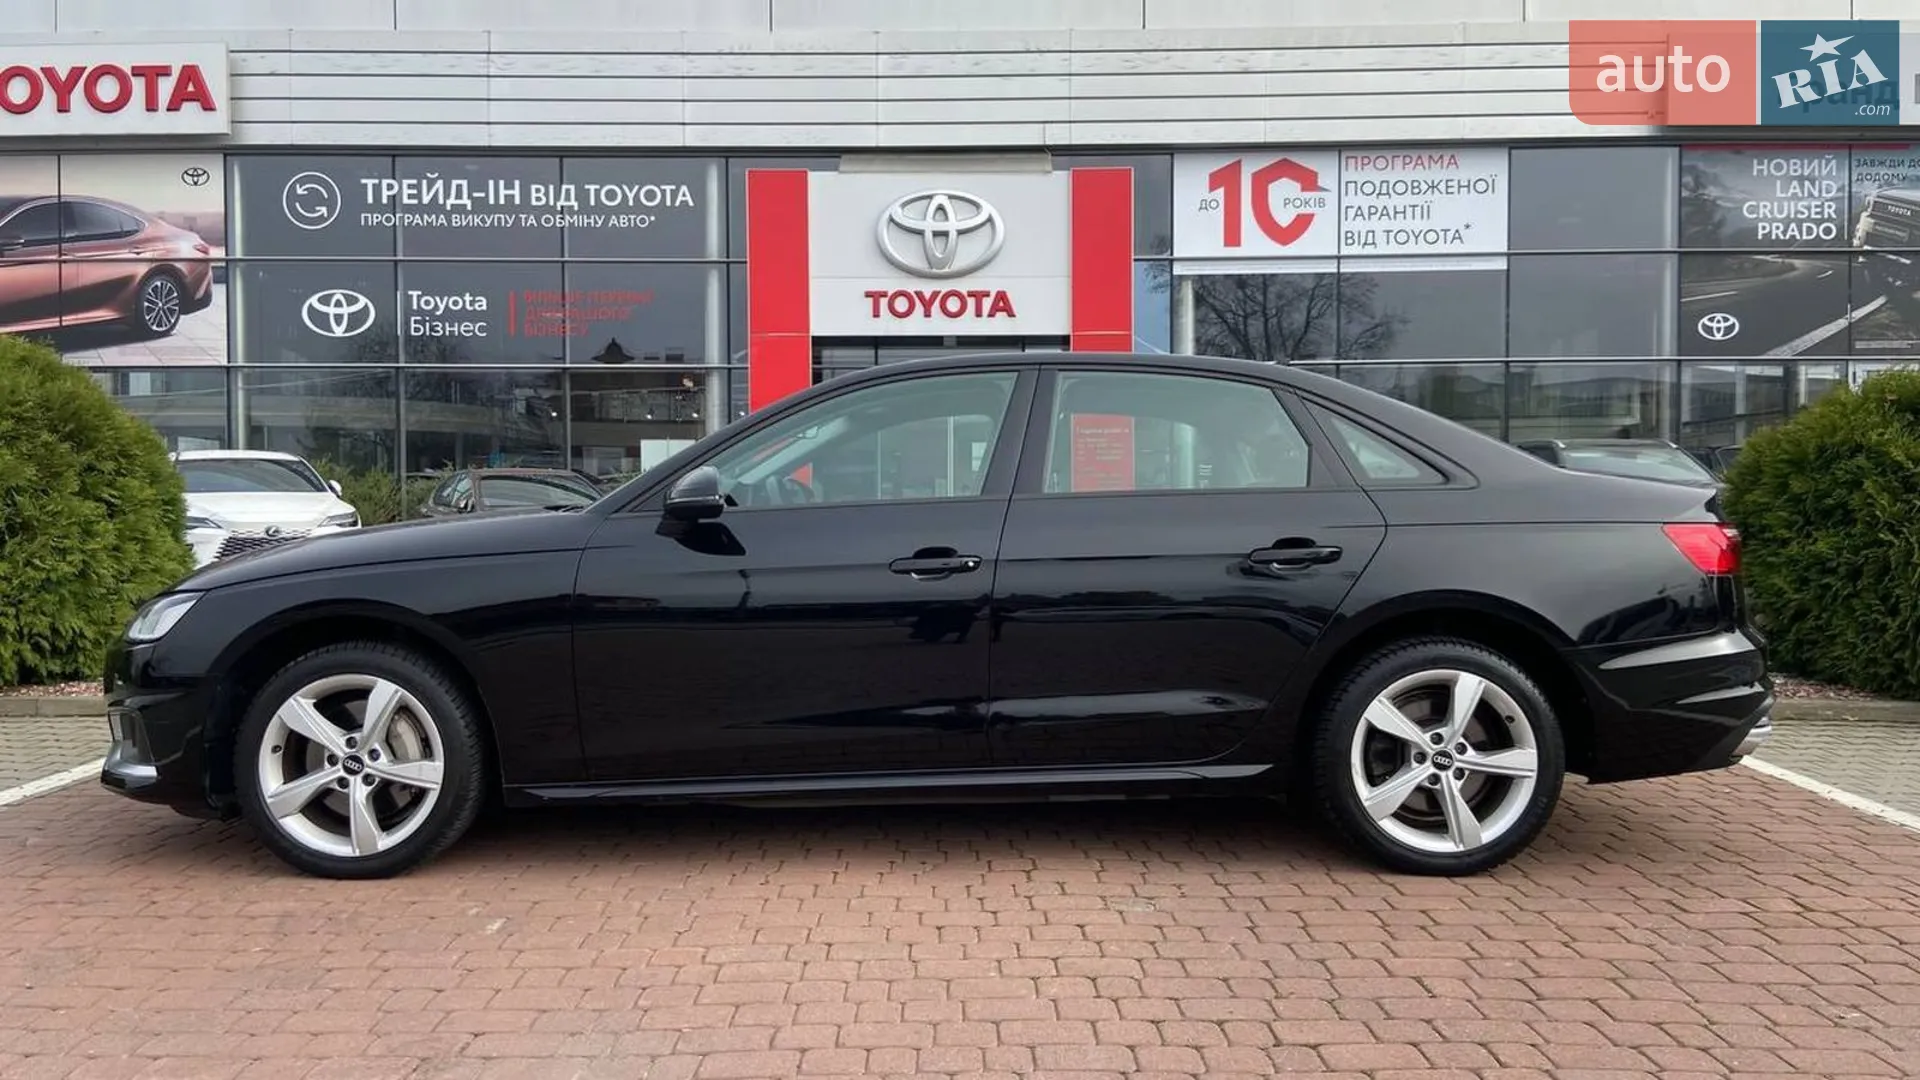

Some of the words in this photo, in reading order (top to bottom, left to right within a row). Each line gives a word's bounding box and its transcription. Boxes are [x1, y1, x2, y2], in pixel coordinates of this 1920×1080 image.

[1344, 154, 1460, 172] ПРОГРАМА
[1752, 155, 1837, 177] НОВИЙ
[360, 172, 521, 211] ТРЕЙД-ІН
[530, 184, 578, 211] ВІД
[584, 184, 695, 207] TOYOTA
[1344, 174, 1497, 199] ПОДОВЖЕНОЇ
[1775, 180, 1837, 198] LAND
[1198, 198, 1220, 212] ДО
[1283, 197, 1326, 210] РОКІВ
[1344, 201, 1432, 222] ГАРАНТІЇ
[1742, 201, 1837, 219] CRUISER
[360, 213, 448, 227] ПРОГРАМА
[452, 213, 516, 228] ВИКУПУ
[519, 214, 538, 227] ТА
[541, 213, 605, 228] ОБМІНУ
[1344, 230, 1378, 248] ВІД
[1757, 222, 1837, 240] PRADO
[408, 290, 488, 315] Toyota
[864, 289, 1016, 319] TOYOTA
[409, 316, 488, 337] Бізнес
